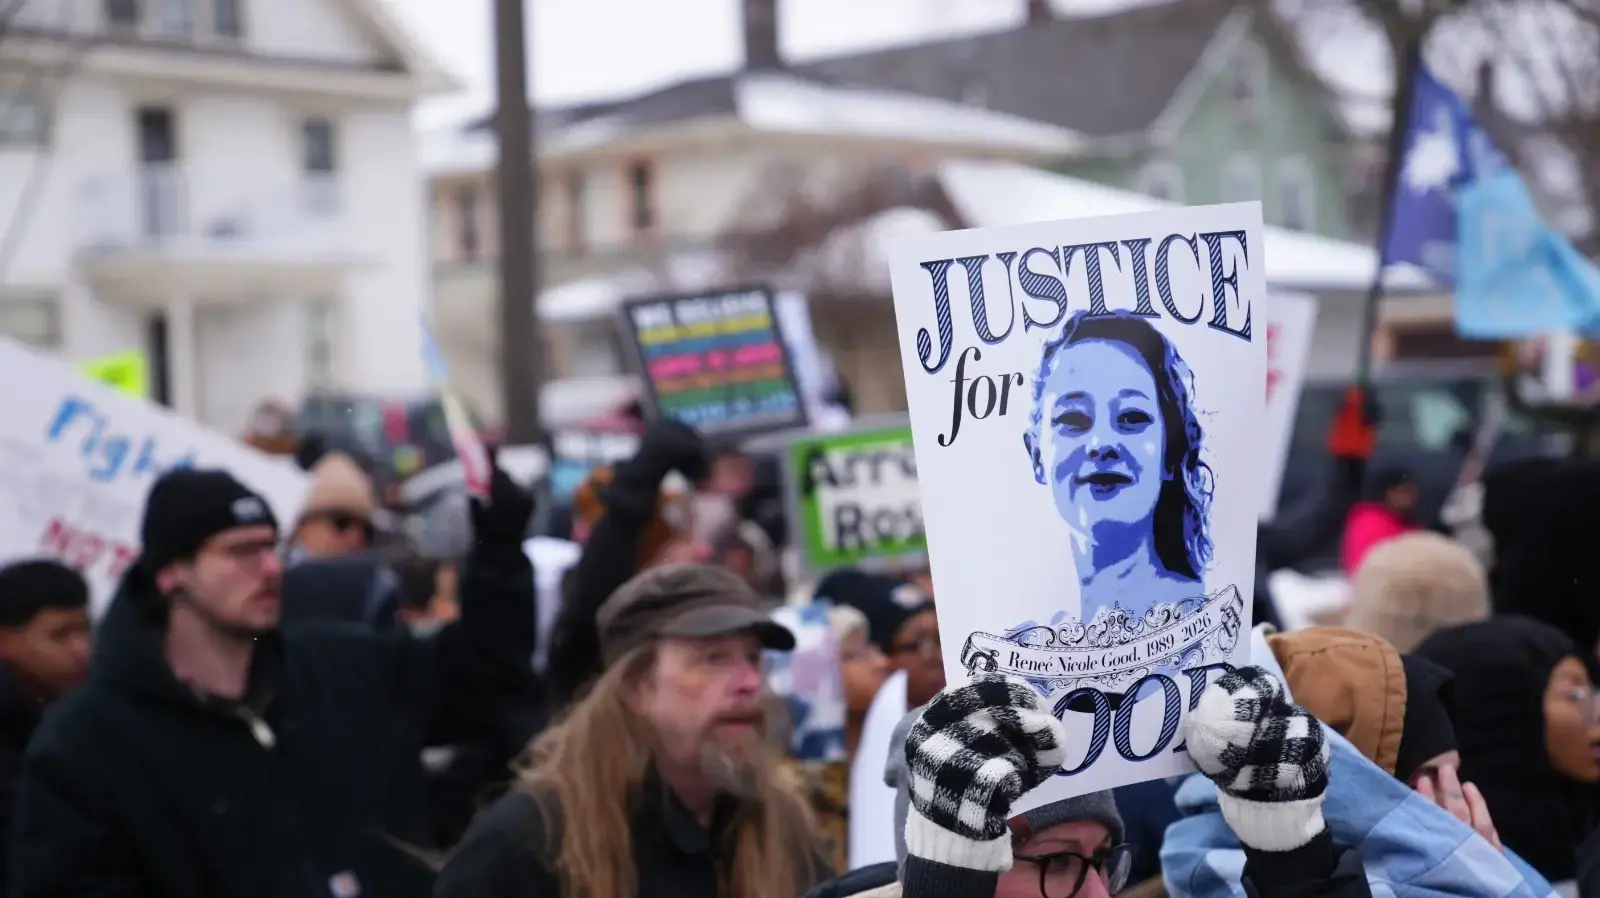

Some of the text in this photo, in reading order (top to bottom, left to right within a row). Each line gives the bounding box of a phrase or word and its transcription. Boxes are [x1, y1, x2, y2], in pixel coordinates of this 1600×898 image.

[916, 229, 1252, 374] JUSTICE
[47, 395, 196, 484] righ
[937, 346, 1024, 447] for
[1055, 656, 1098, 673] Nicole
[1146, 636, 1175, 659] 1989
[1181, 613, 1211, 642] 2026
[1052, 663, 1237, 776] OO
